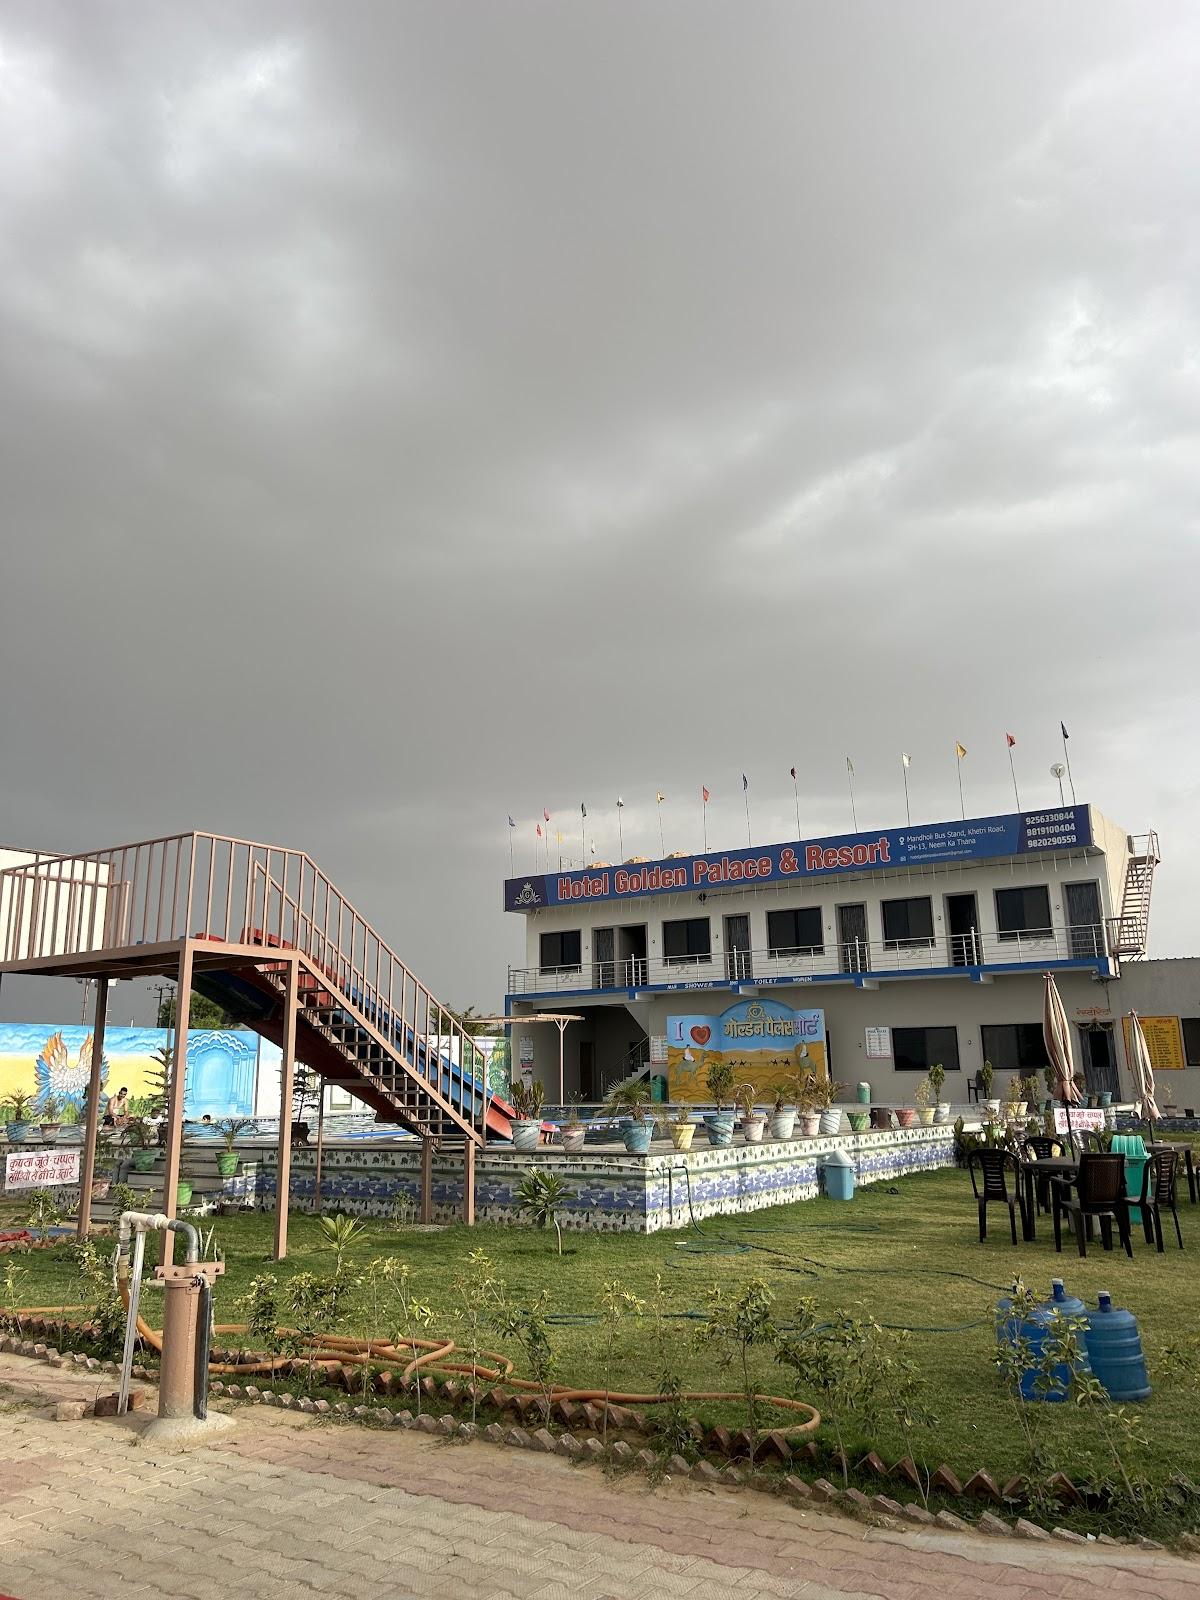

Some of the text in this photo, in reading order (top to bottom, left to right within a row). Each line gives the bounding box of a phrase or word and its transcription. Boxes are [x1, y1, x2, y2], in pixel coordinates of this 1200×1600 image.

[1025, 811, 1075, 825] 9256330844
[934, 831, 946, 840] Bus
[946, 830, 967, 838] Stand,
[967, 827, 987, 836] Khetri
[987, 825, 1006, 834] Road,
[1026, 823, 1076, 836] 9819100404
[928, 841, 946, 850] Neem
[947, 840, 956, 848] Ka
[956, 838, 977, 847] Thana
[1027, 834, 1077, 848] 9820290559
[558, 836, 891, 901] Hotel Golden Palace & Resort
[674, 1020, 684, 1042] I
[9, 1157, 33, 1171] कृपया
[35, 1154, 49, 1169] जूते
[38, 1166, 56, 1180] नीचे
